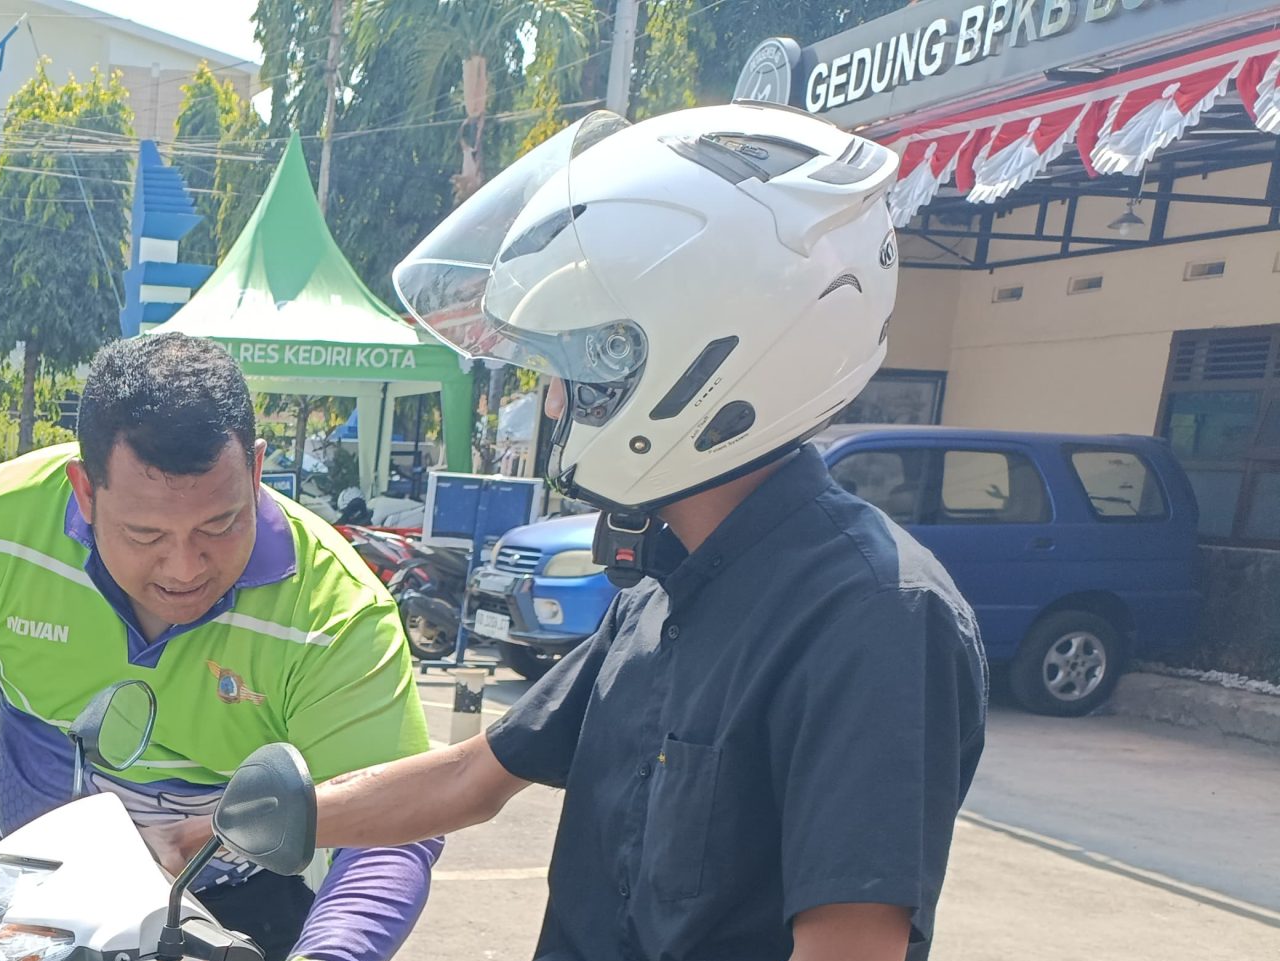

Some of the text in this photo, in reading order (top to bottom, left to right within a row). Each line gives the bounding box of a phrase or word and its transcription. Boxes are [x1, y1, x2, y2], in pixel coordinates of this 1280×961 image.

[806, 0, 1071, 113] GEDUNG BPKB
[284, 345, 351, 367] KEDIRI
[356, 348, 417, 370] KOTA
[6, 615, 69, 643] NOVAN
